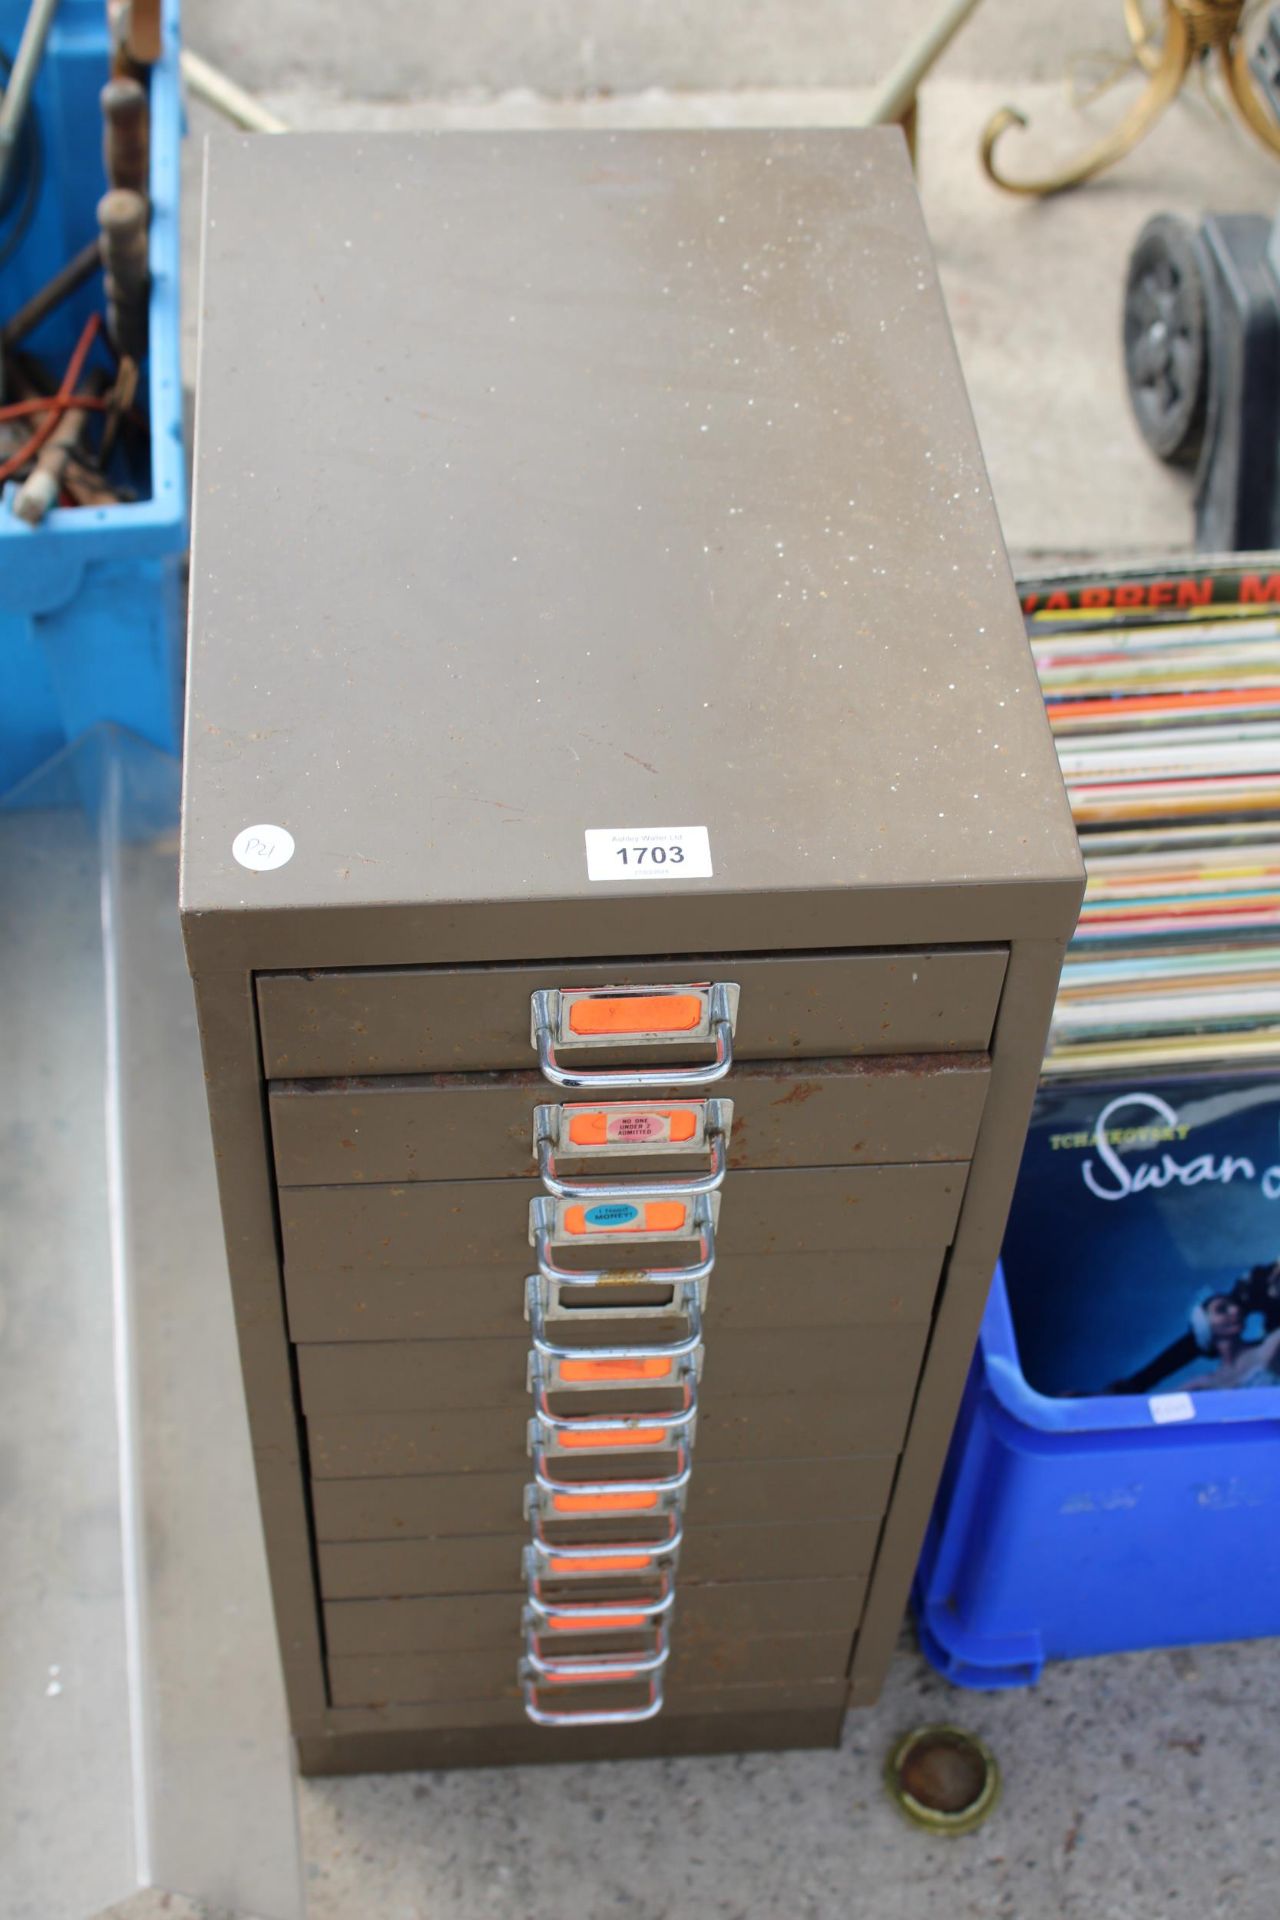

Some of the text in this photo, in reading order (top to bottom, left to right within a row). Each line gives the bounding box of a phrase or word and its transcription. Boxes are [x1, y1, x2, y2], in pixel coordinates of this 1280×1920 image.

[616, 846, 685, 865] 1703
[1050, 1125, 1190, 1150] TCHAKOVSKY
[1082, 1092, 1255, 1200] Swan
